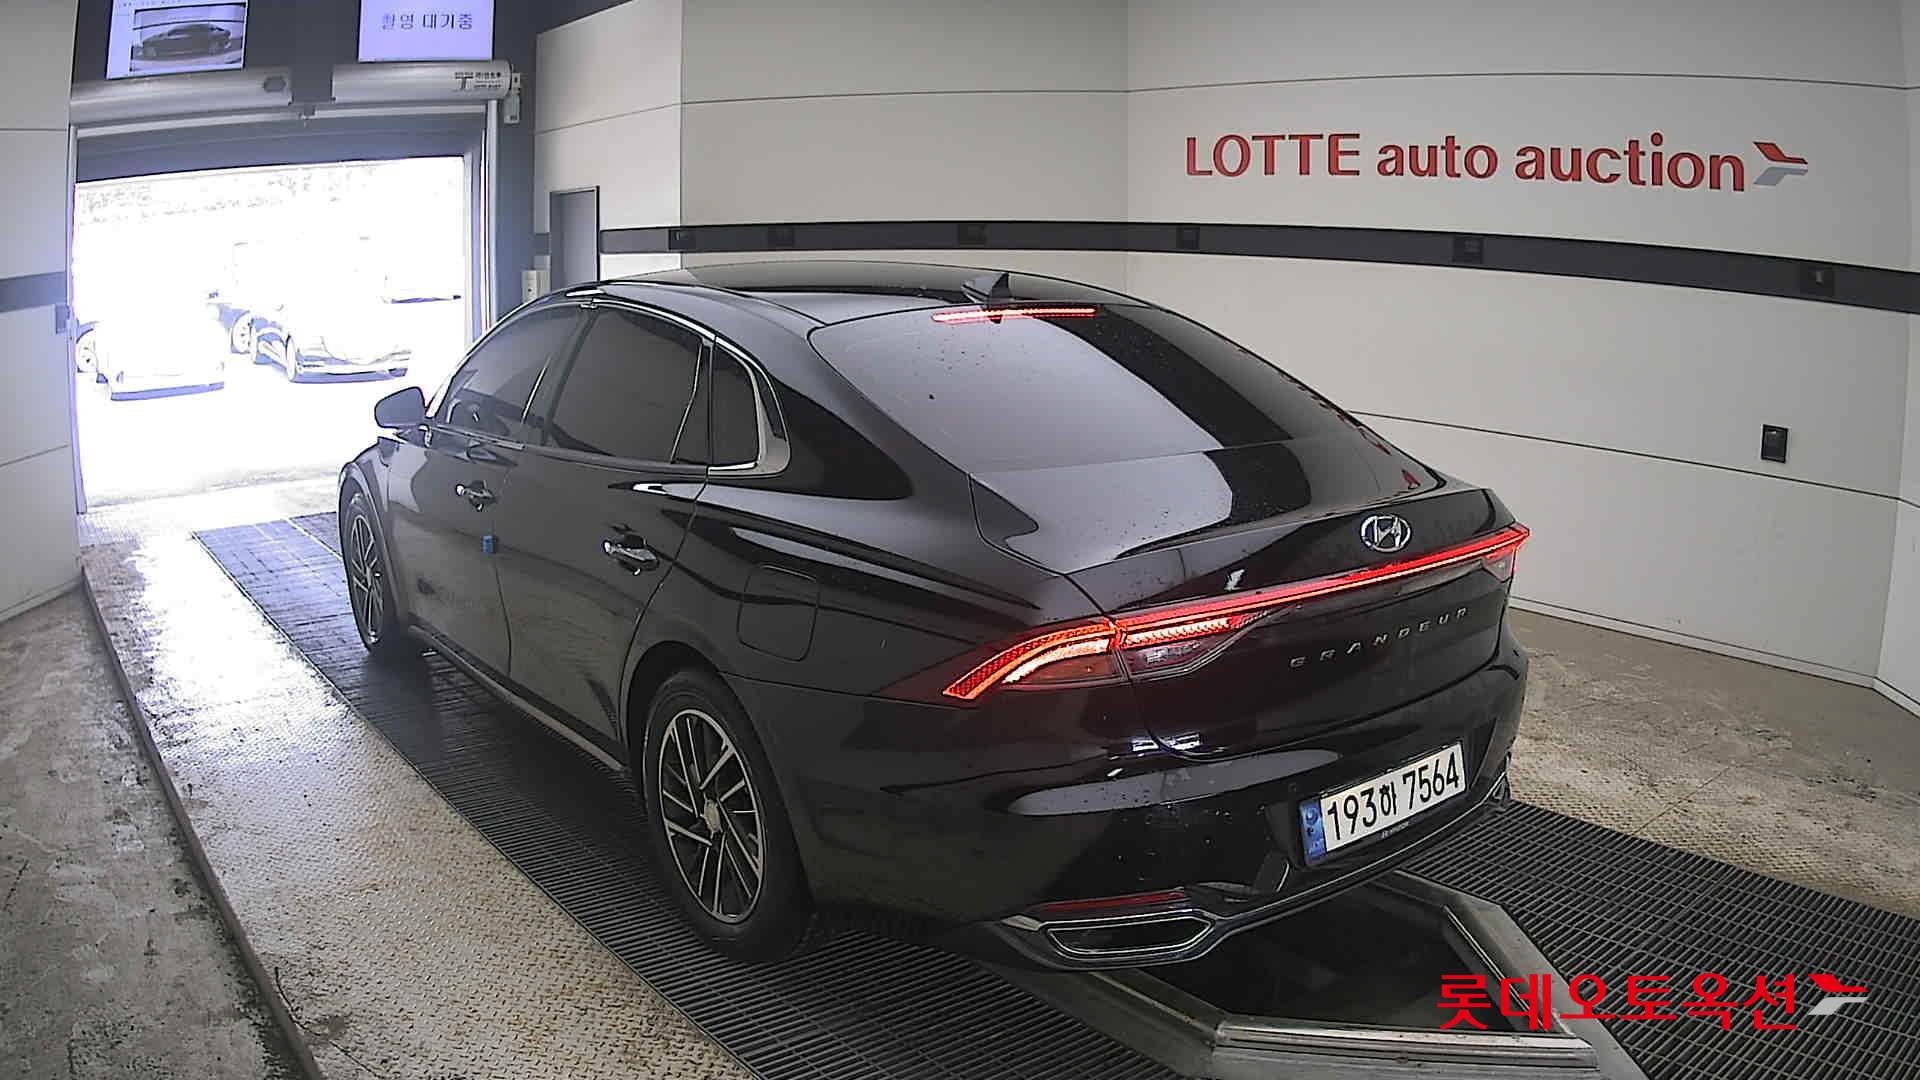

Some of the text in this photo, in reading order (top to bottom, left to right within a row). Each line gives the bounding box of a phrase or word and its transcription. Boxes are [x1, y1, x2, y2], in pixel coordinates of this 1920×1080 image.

[422, 13, 472, 30] 대기중
[1186, 132, 1746, 192] LOTTE auto auction
[1289, 606, 1468, 668] GRANDEUR
[1327, 752, 1460, 841] 193하 7564
